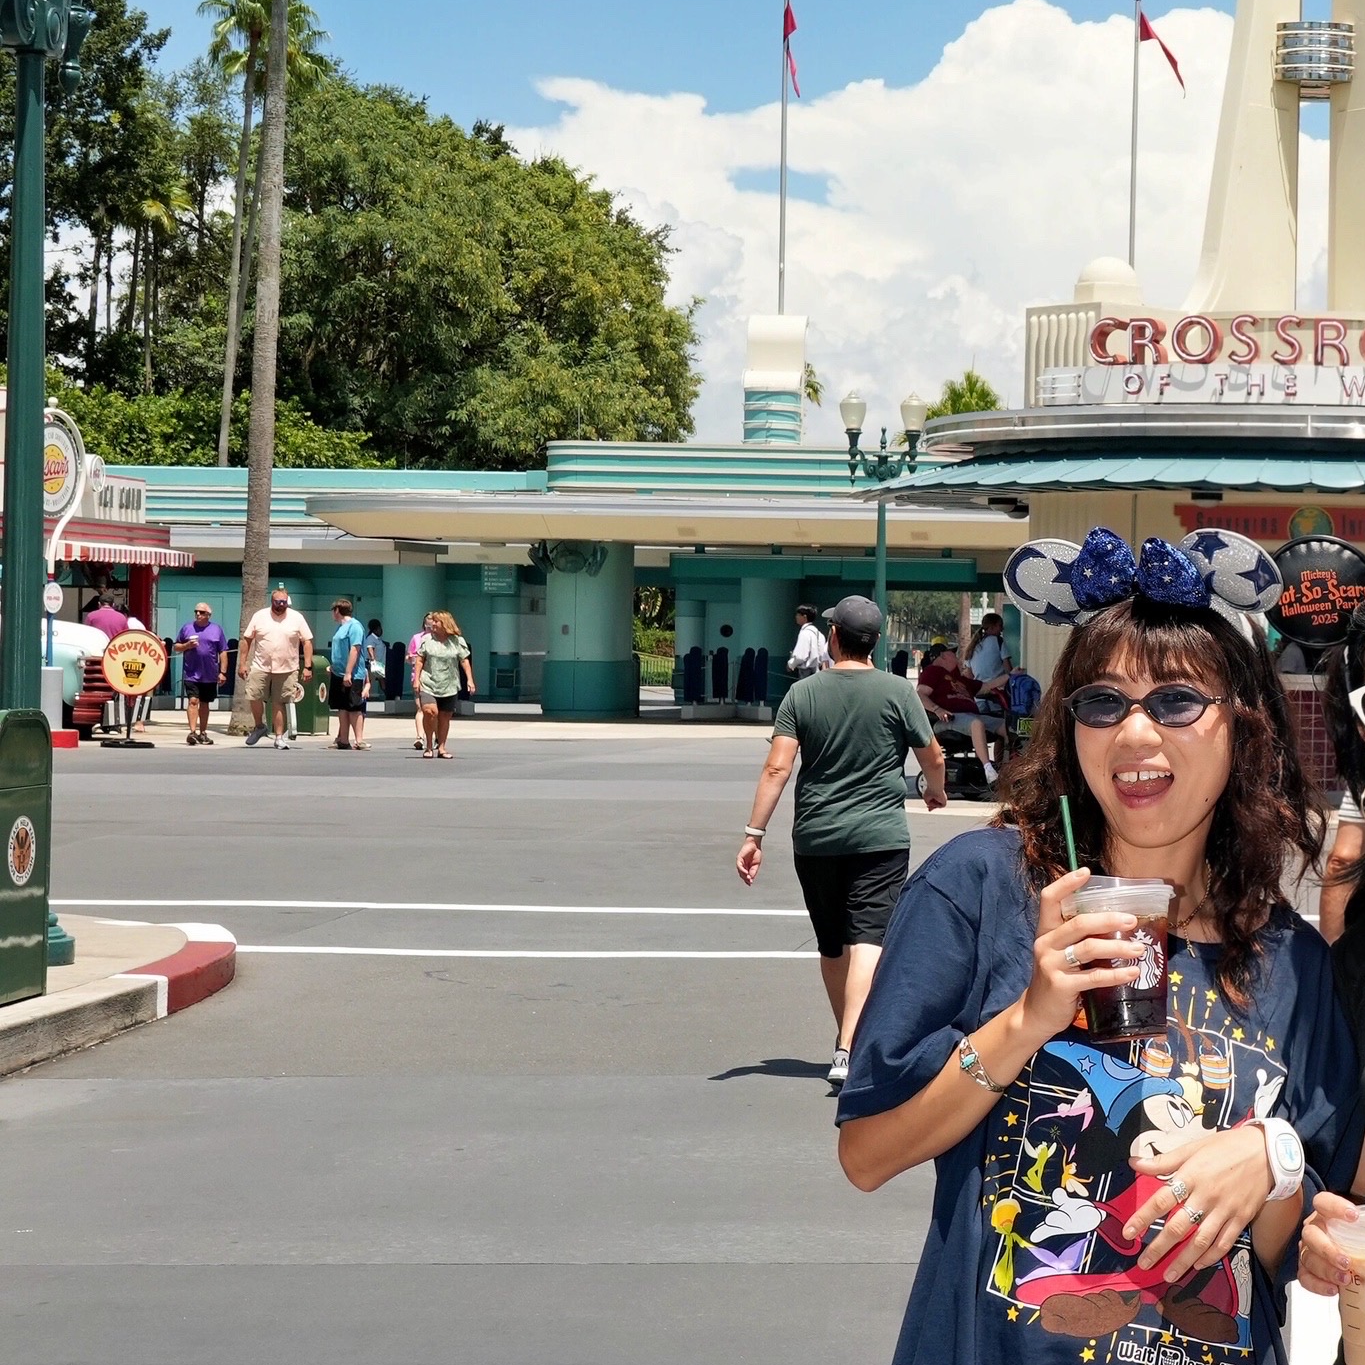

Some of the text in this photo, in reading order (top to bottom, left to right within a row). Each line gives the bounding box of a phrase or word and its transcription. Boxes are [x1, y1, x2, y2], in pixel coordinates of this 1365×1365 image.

[1122, 372, 1172, 395] OF
[1214, 373, 1298, 397] THE
[44, 457, 69, 476] scar's
[1301, 569, 1337, 582] Mickey's
[1281, 601, 1332, 617] Halloween
[1311, 612, 1339, 626] 2025
[1117, 1341, 1155, 1365] Walt
